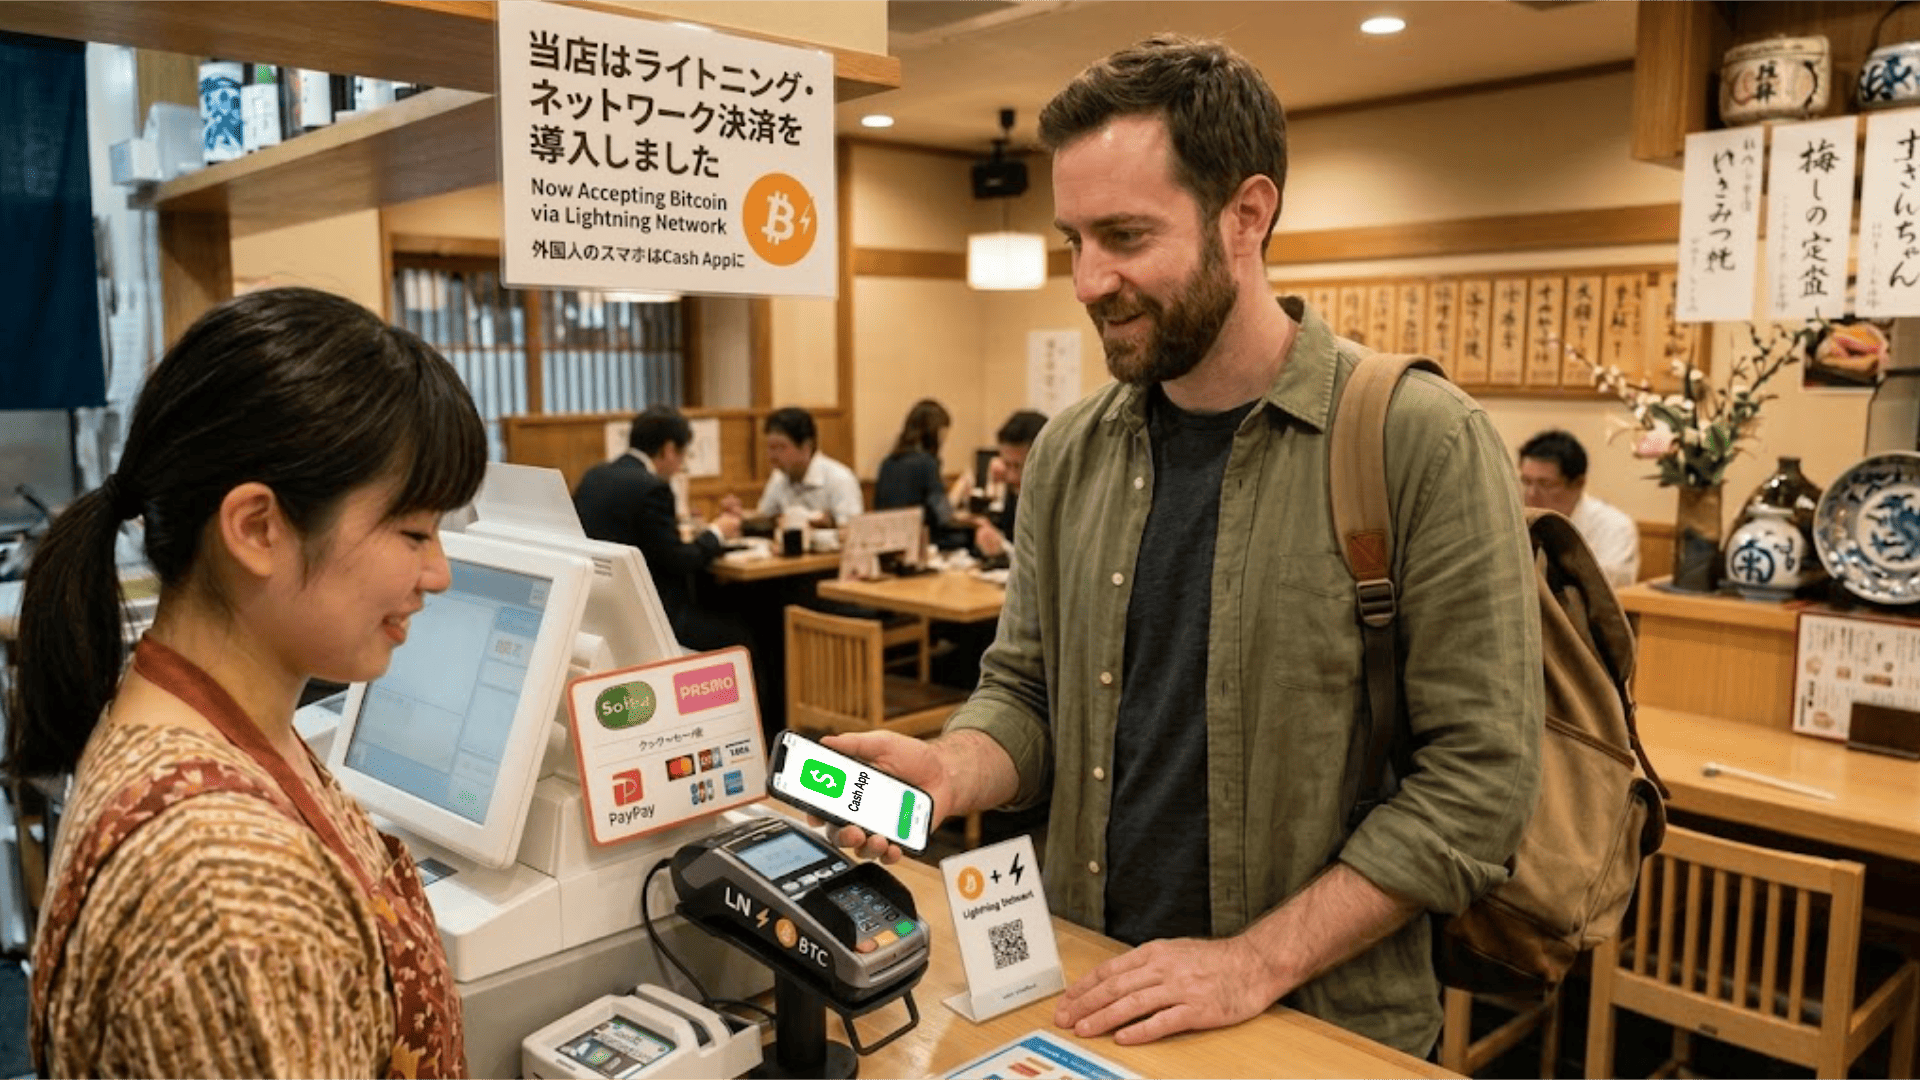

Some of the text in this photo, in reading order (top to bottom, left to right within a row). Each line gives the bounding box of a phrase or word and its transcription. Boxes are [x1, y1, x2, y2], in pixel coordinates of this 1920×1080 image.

[530, 79, 803, 146] ネットワーク決済を
[530, 124, 720, 178] 導入しました
[531, 177, 728, 211] Now Accepting Bitcoin
[531, 204, 728, 235] via Lightning Network
[848, 771, 871, 812] Cash App
[608, 804, 655, 827] PayPay
[724, 886, 752, 917] LN
[798, 936, 829, 968] BTC
